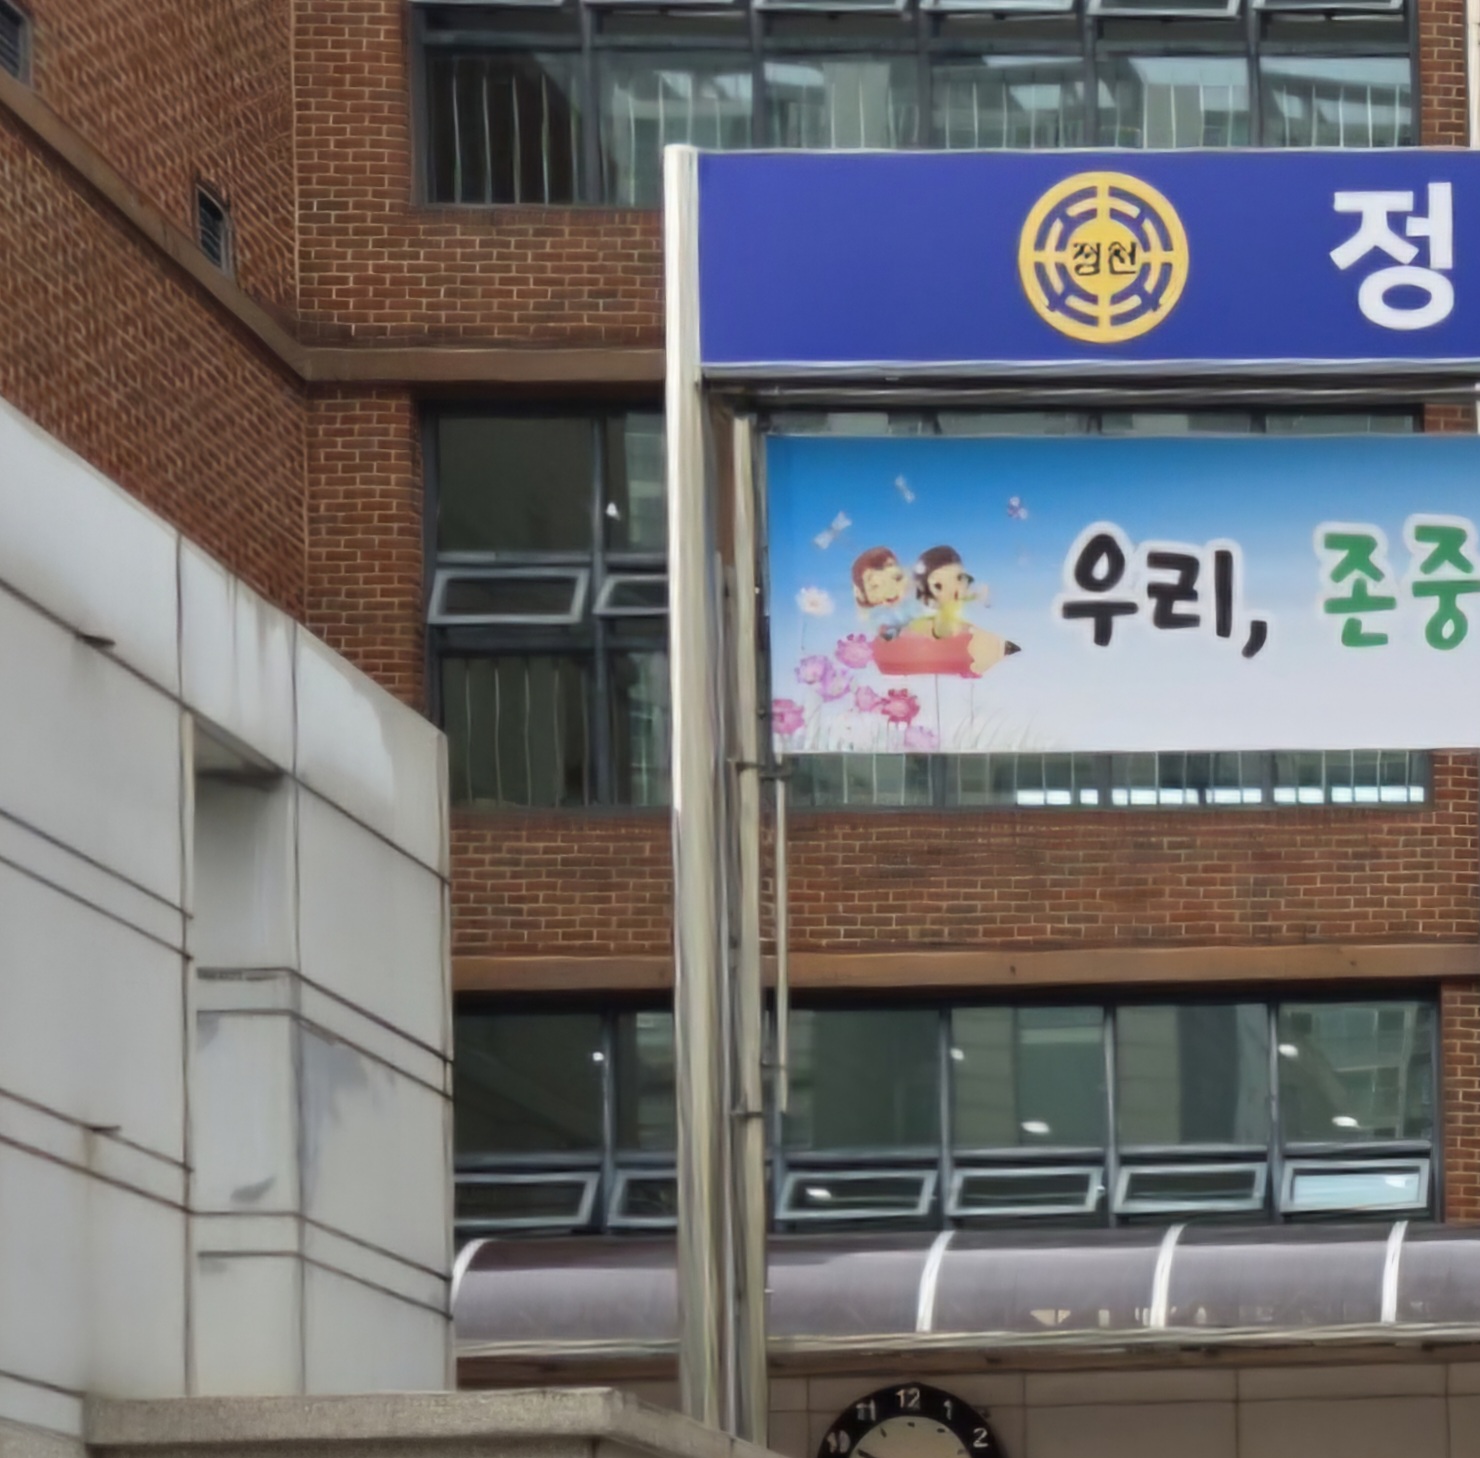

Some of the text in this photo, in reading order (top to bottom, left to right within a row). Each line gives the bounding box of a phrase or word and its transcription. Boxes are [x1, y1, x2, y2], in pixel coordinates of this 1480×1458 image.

[1062, 533, 1268, 658] 우리,
[896, 1388, 920, 1410] 12
[944, 1400, 951, 1420] 1
[973, 1427, 988, 1448] 2
